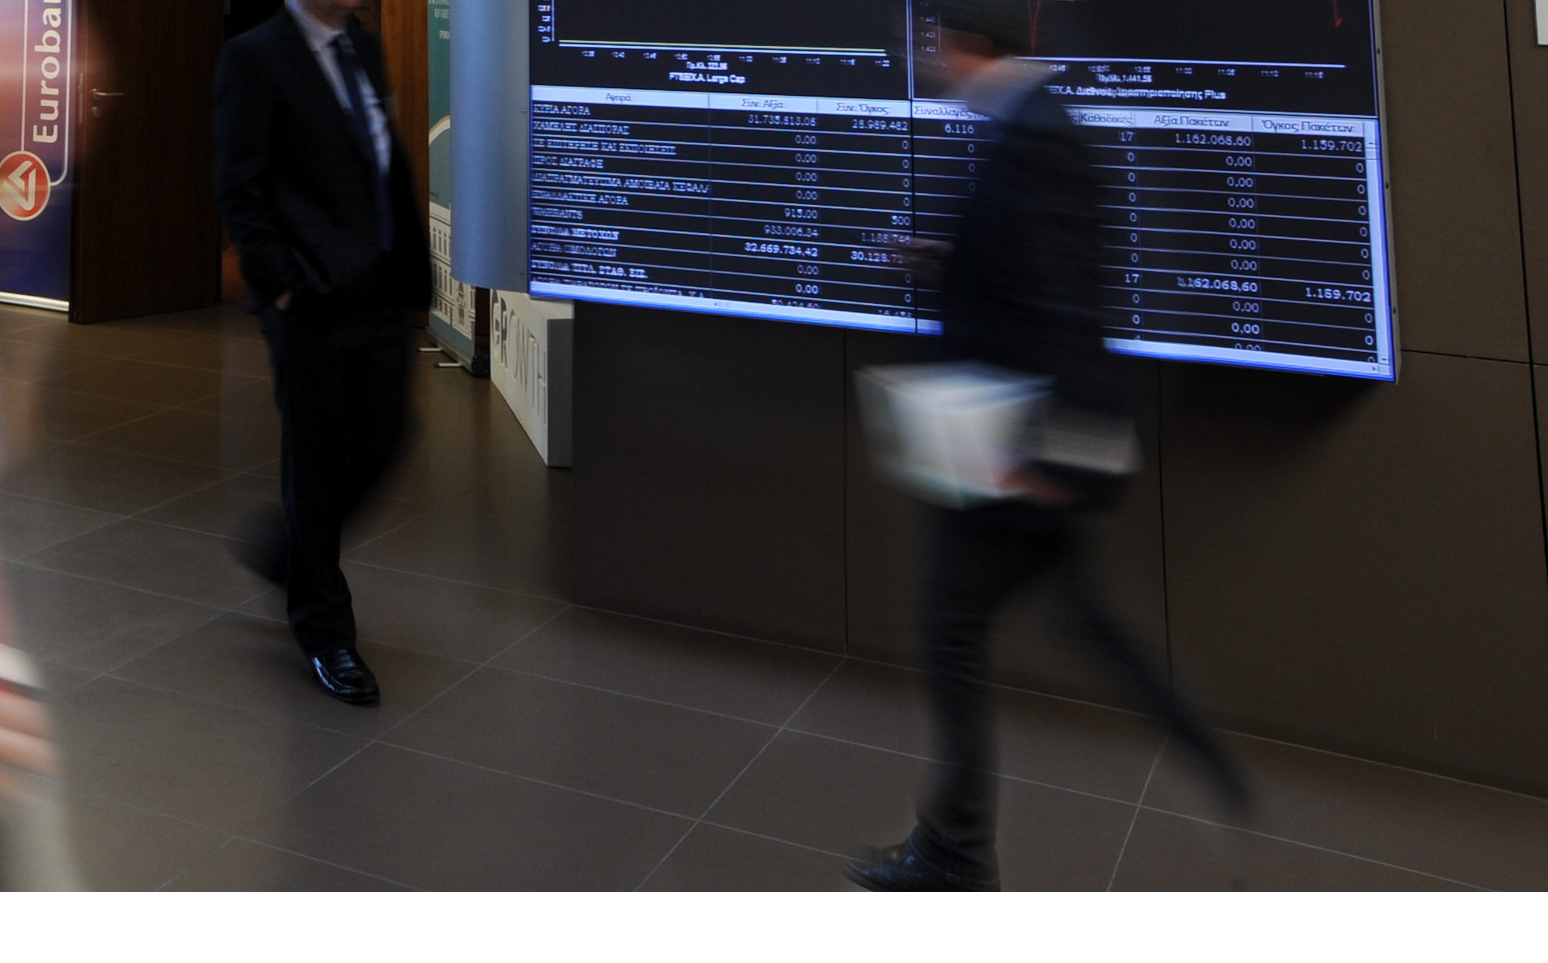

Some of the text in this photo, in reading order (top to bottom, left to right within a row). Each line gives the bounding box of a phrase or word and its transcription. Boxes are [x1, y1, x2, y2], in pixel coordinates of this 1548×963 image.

[944, 124, 974, 134] 6.116
[1301, 139, 1363, 152] 1.159.702
[891, 215, 910, 225] 500
[850, 250, 909, 264] 30.128.72
[1124, 273, 1140, 284] 17
[1305, 287, 1372, 303] 1.159.702
